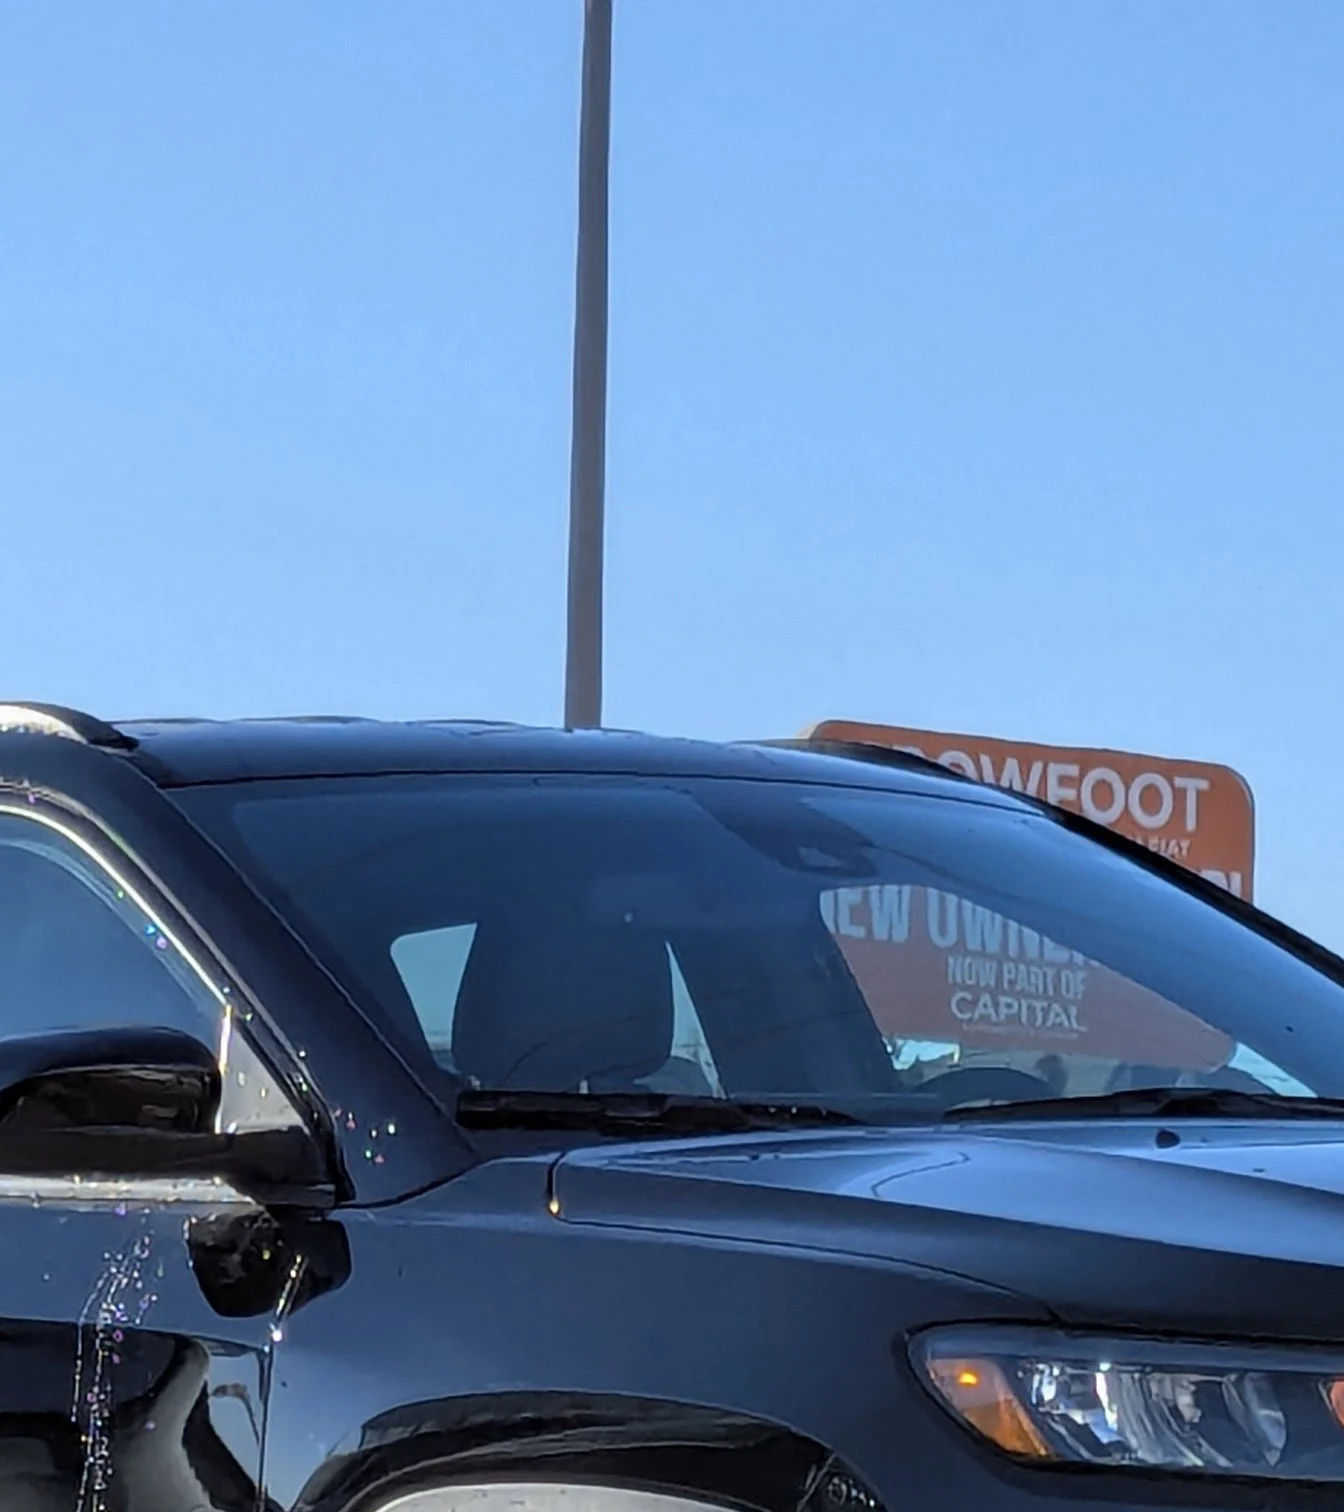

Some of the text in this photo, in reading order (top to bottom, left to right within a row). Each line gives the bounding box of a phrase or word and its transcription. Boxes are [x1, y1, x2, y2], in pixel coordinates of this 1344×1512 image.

[947, 955, 1087, 1000] NOW PART OF
[950, 991, 1089, 1032] CAPITAL
